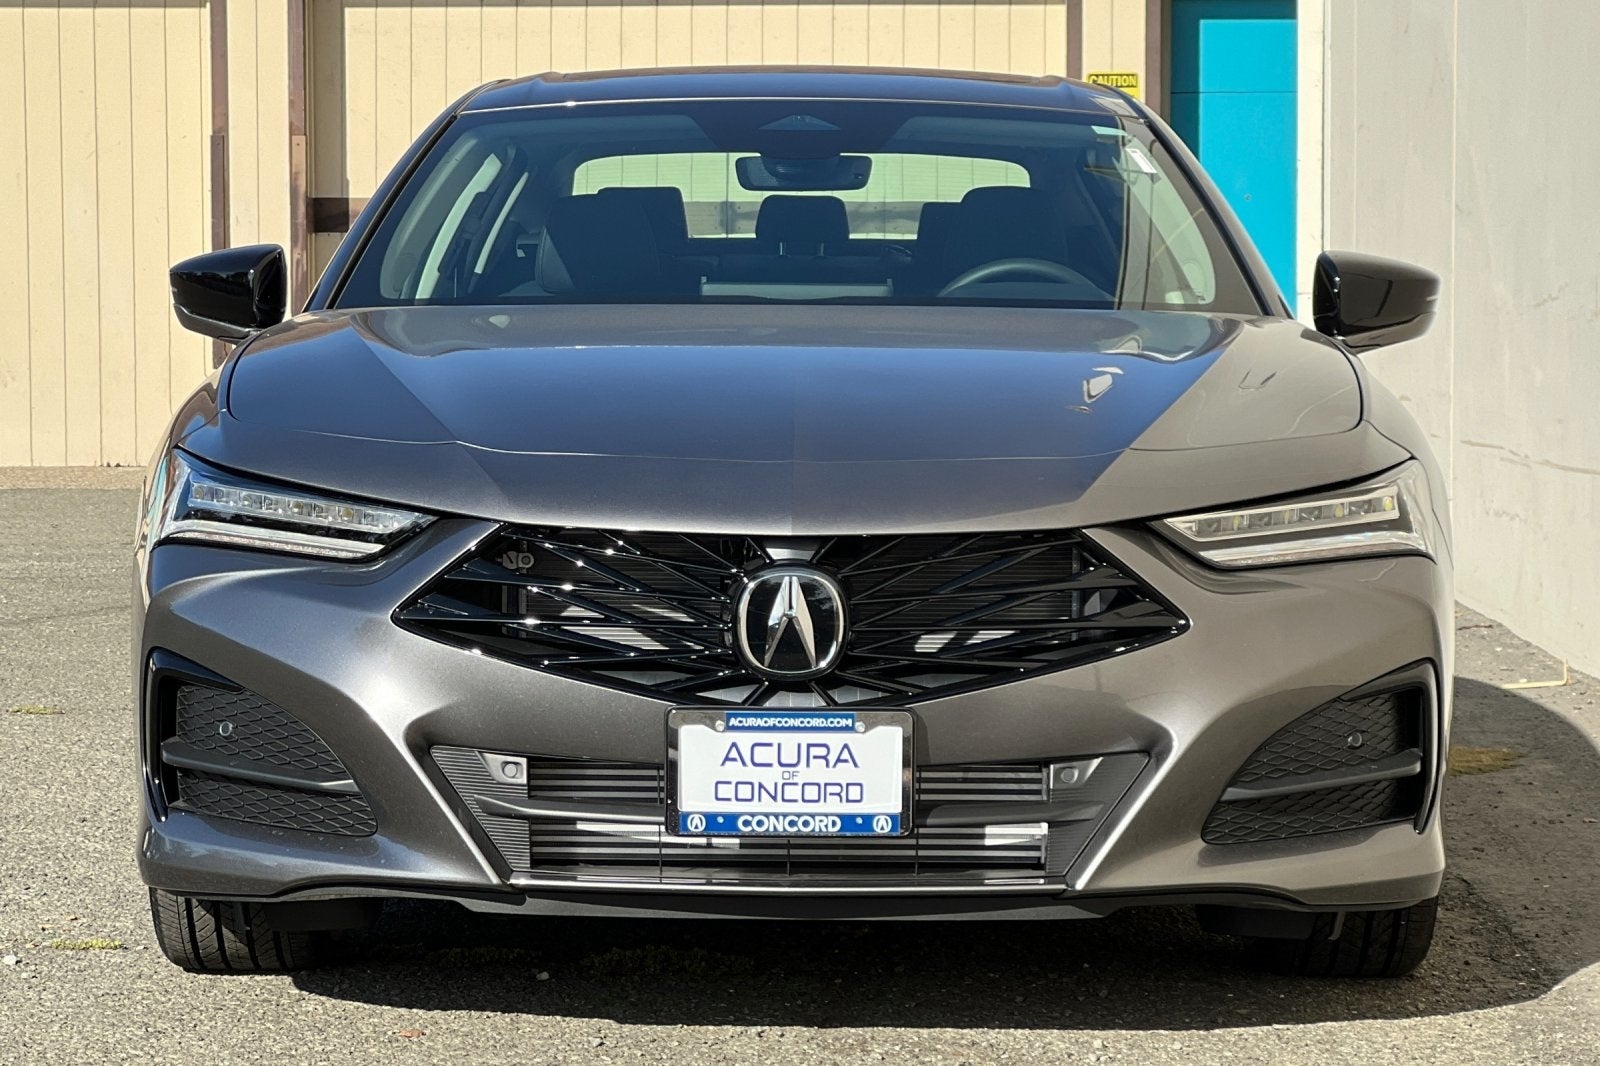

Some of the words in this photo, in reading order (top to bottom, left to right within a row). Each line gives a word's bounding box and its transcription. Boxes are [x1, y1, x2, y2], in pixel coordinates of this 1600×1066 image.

[1089, 75, 1137, 87] CAUTION
[728, 717, 853, 728] ACURAOFCONCORD.COM
[720, 741, 860, 768] ACURA
[781, 770, 800, 781] OF
[714, 780, 864, 803] CONCORD
[737, 815, 842, 832] CONCORD
